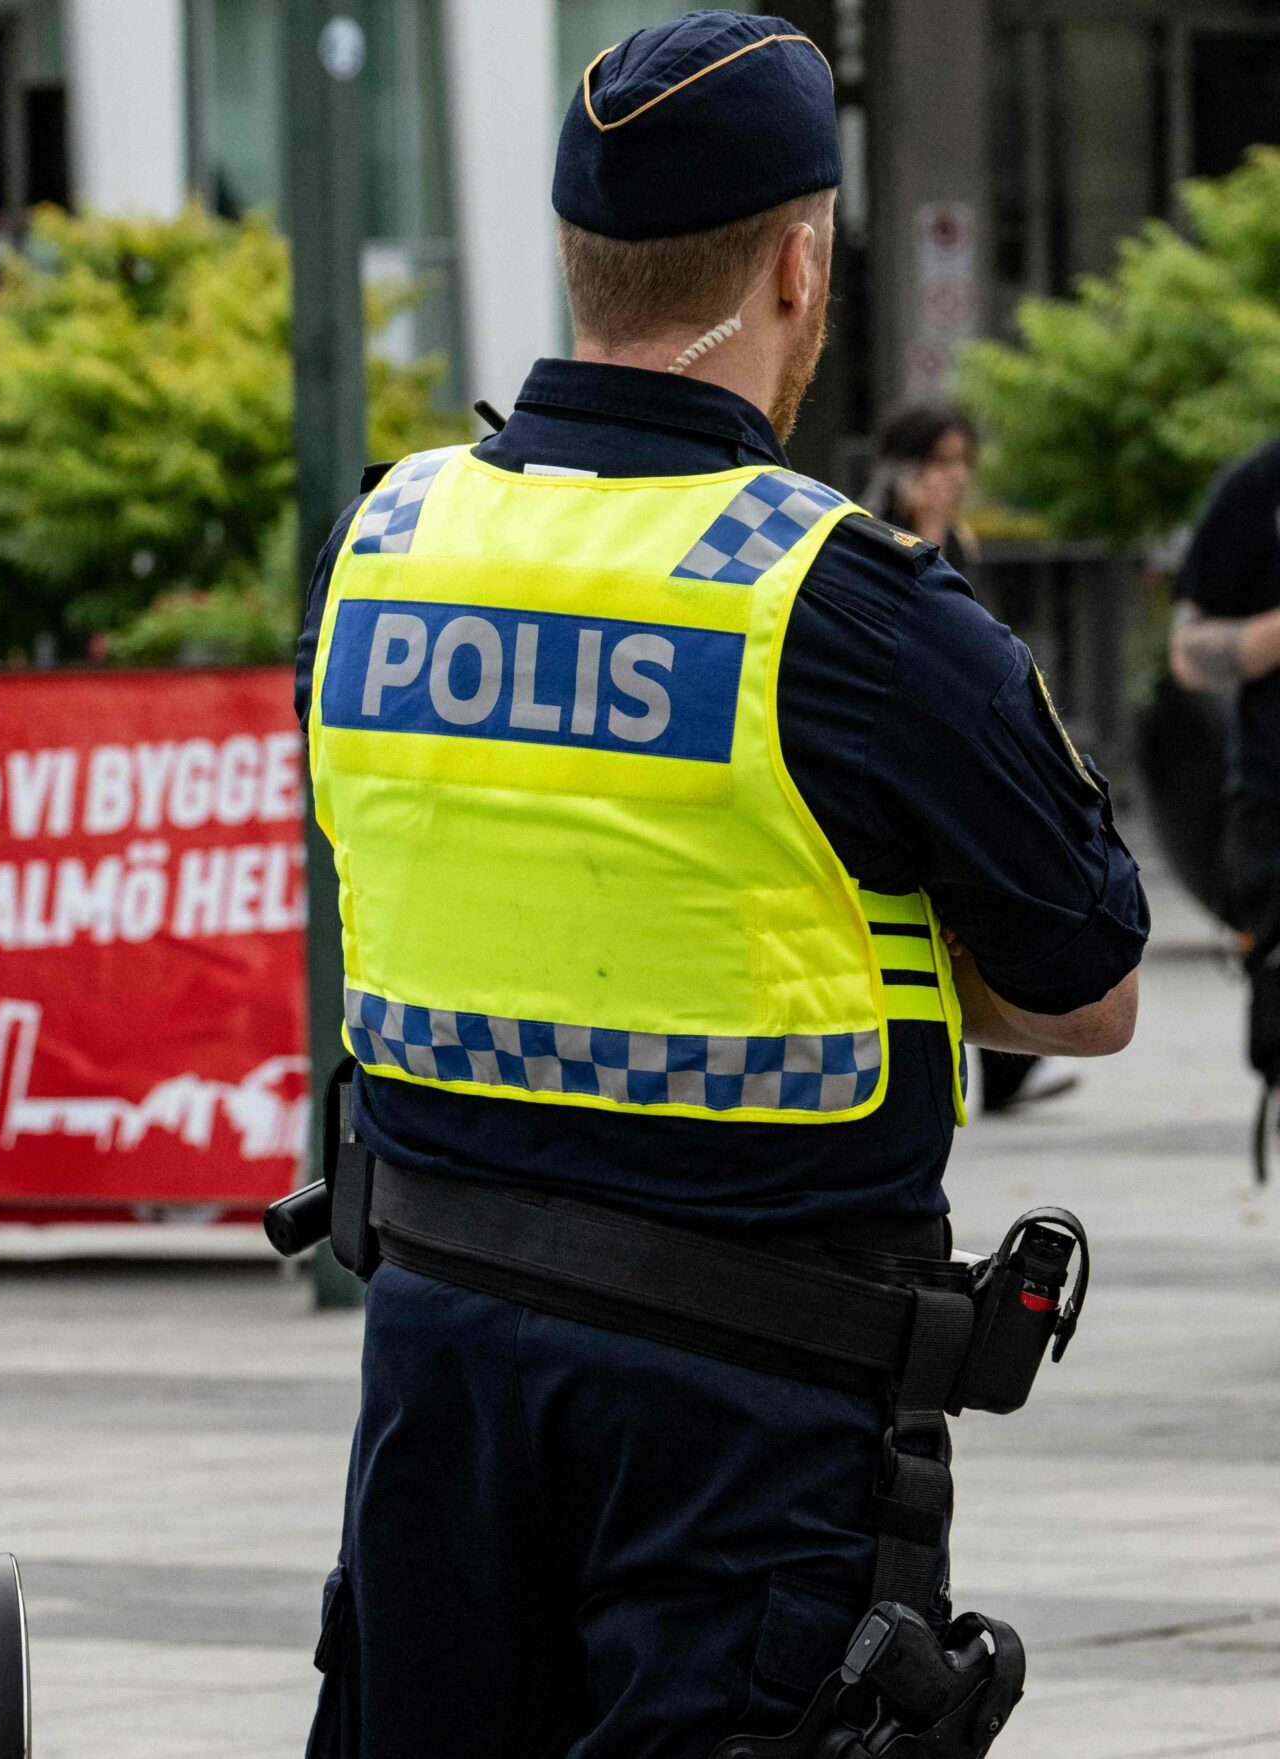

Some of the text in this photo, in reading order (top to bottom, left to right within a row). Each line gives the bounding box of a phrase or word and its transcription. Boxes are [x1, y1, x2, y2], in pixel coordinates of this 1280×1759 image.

[361, 612, 676, 743] POLIS
[7, 732, 307, 838] VI BYGGE
